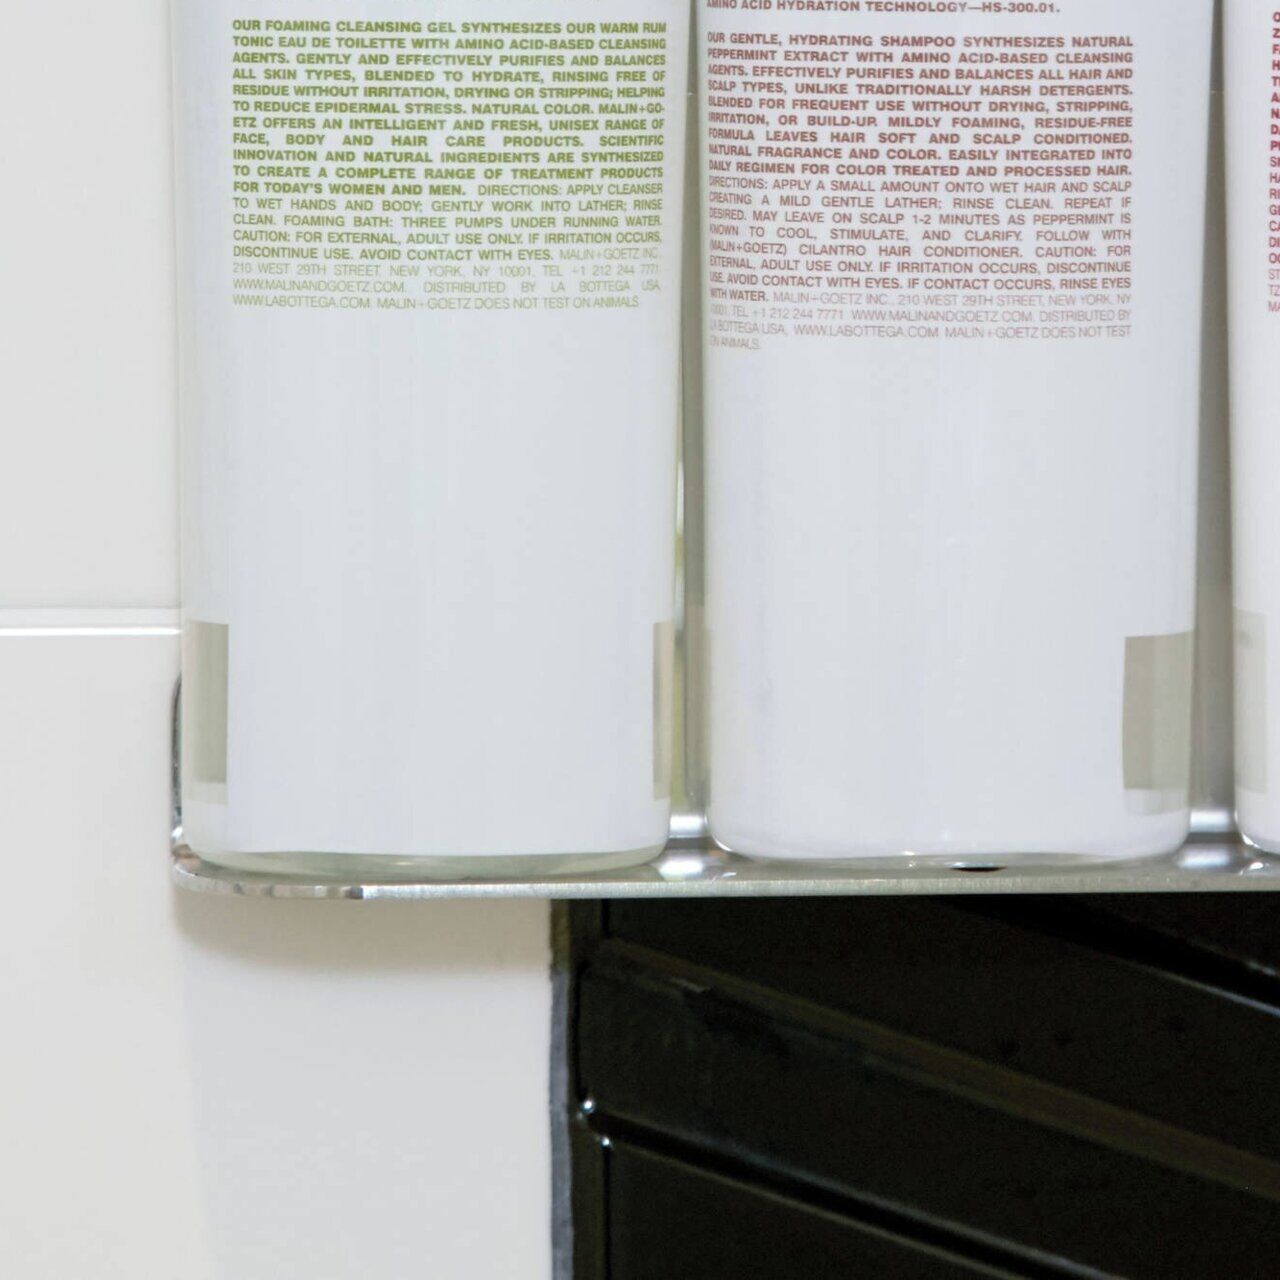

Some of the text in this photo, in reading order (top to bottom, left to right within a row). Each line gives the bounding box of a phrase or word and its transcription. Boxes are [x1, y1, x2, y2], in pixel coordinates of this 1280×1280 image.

[741, 0, 772, 10] ACID
[777, 0, 860, 12] HYDRATION
[232, 19, 668, 34] OUR FOAMING CLEANSING GEL SYNTHESIZES OUR WARM RUM
[706, 31, 1134, 48] OUR GENTLE, HYDRATING SHAMPOO SYNTHESIZES NATURAL
[232, 51, 667, 67] AGENTS. GENTLY AND EFFECTIVELY PURIFIES AND BALANCES
[706, 47, 1134, 65] PEPPERMINT EXTRACT WITH AMINO ACID-BASED CLEANSING
[706, 79, 1133, 97] SCALP TYPES, UNLIKE TRADITIONALLY HARSH DETERGENTS.
[706, 111, 1134, 129] IRRITATION, OR BUILD-UP. MILDLY FOAMING, RESIDUE-FREE
[232, 132, 665, 148] FACE, BODY AND HAIR CARE PRODUCTS. SCIENTIFIC
[706, 127, 1133, 145] FORMULA LEAVES HAIR SOFT AND SCALP CONDITIONED.
[232, 148, 665, 164] INNOVATION AND NATURAL INGREDIENTS ARE SYNTHESIZED
[232, 213, 662, 229] CLEAN. FOAMING BATH: THREE PUMPS UNDER RUNNING WATER.
